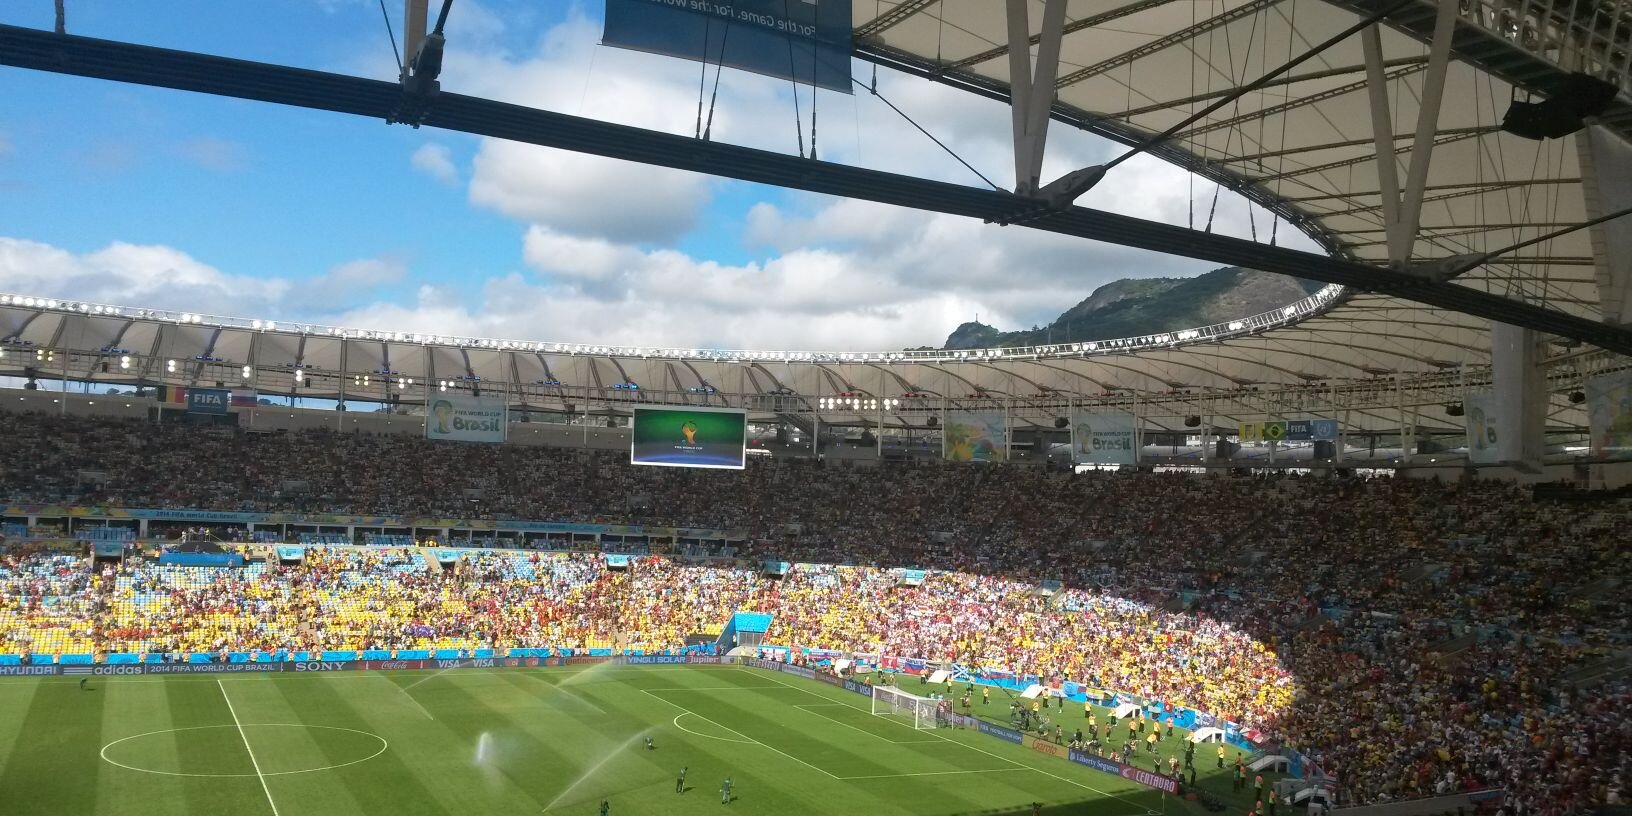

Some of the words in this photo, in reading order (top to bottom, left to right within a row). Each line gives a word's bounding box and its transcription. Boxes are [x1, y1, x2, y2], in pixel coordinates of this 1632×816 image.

[194, 394, 221, 404] FIFA
[453, 416, 500, 431] Brasil
[1291, 425, 1307, 433] FIFA
[1093, 437, 1131, 450] Brasil
[438, 660, 460, 668] VISA
[472, 659, 494, 667] VISA
[689, 656, 719, 664] Jupiler
[0, 665, 56, 675] HYUNDAI
[94, 664, 142, 675] adidas
[150, 665, 170, 673] 2014
[193, 664, 224, 672] WORLD
[295, 662, 346, 671] SONY
[845, 680, 856, 691] VISA
[859, 686, 871, 697] VISA
[1076, 751, 1097, 766] Liberty
[1098, 759, 1120, 773] Seguros
[1135, 770, 1175, 793] CENTAURO
